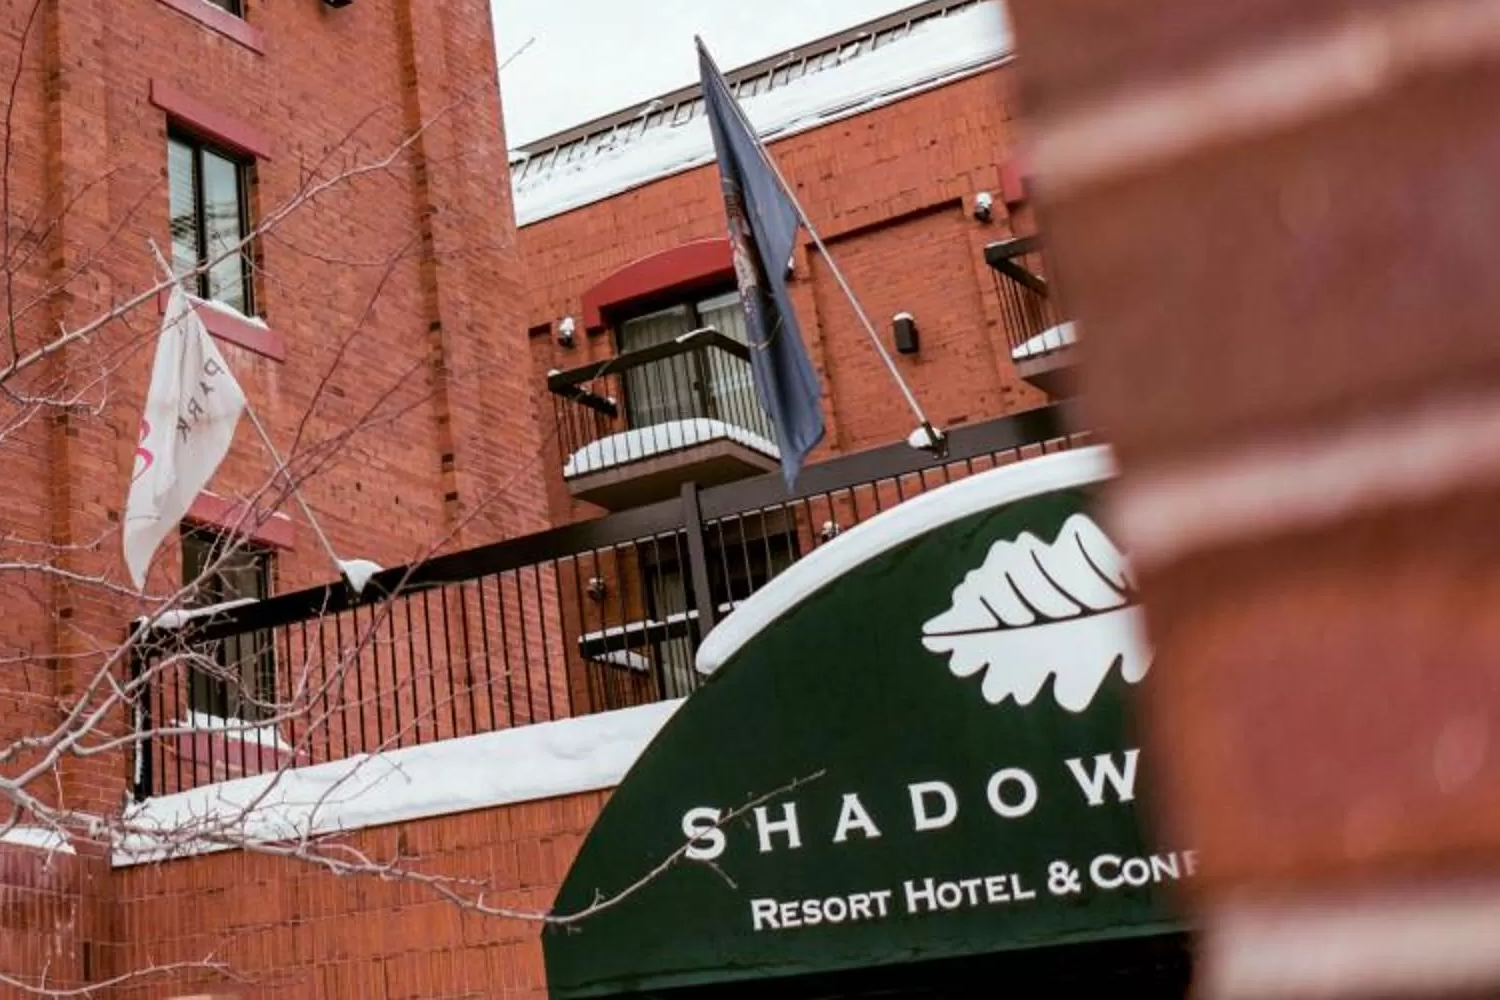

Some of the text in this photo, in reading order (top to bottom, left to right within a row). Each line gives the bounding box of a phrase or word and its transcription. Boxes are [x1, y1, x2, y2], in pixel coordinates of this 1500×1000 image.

[681, 748, 1141, 861] SHADOW
[750, 889, 892, 932] RESORT
[905, 872, 1036, 914] HOTEL
[1046, 860, 1082, 896] &
